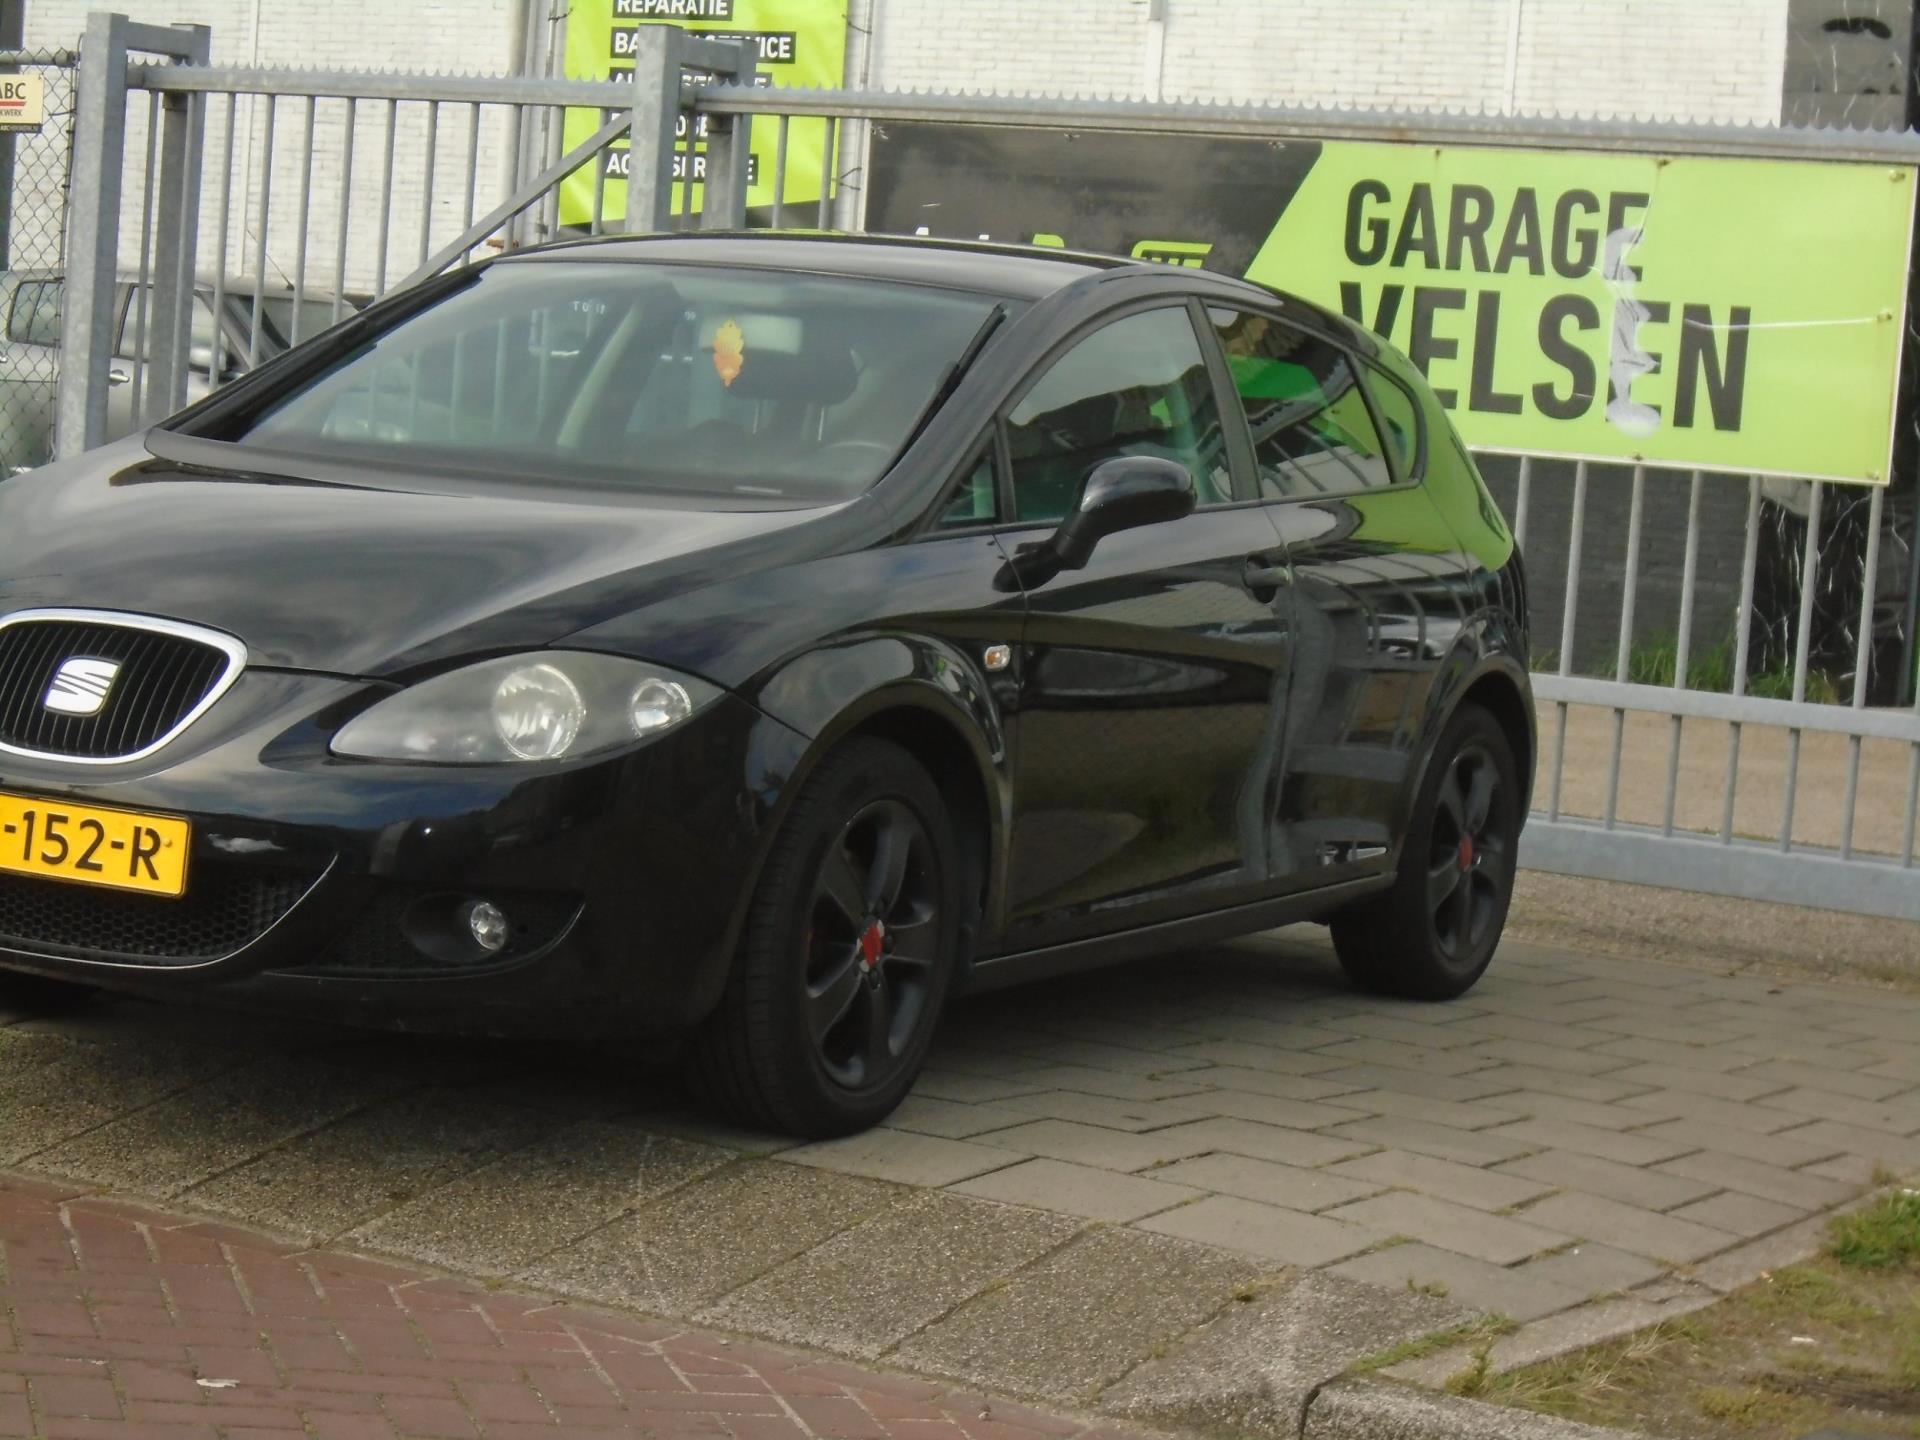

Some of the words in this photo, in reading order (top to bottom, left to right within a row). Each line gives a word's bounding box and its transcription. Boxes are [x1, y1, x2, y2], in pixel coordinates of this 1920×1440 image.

[617, 0, 728, 15] REPARATIE
[0, 82, 26, 99] BC
[1343, 179, 1650, 281] GARAGE
